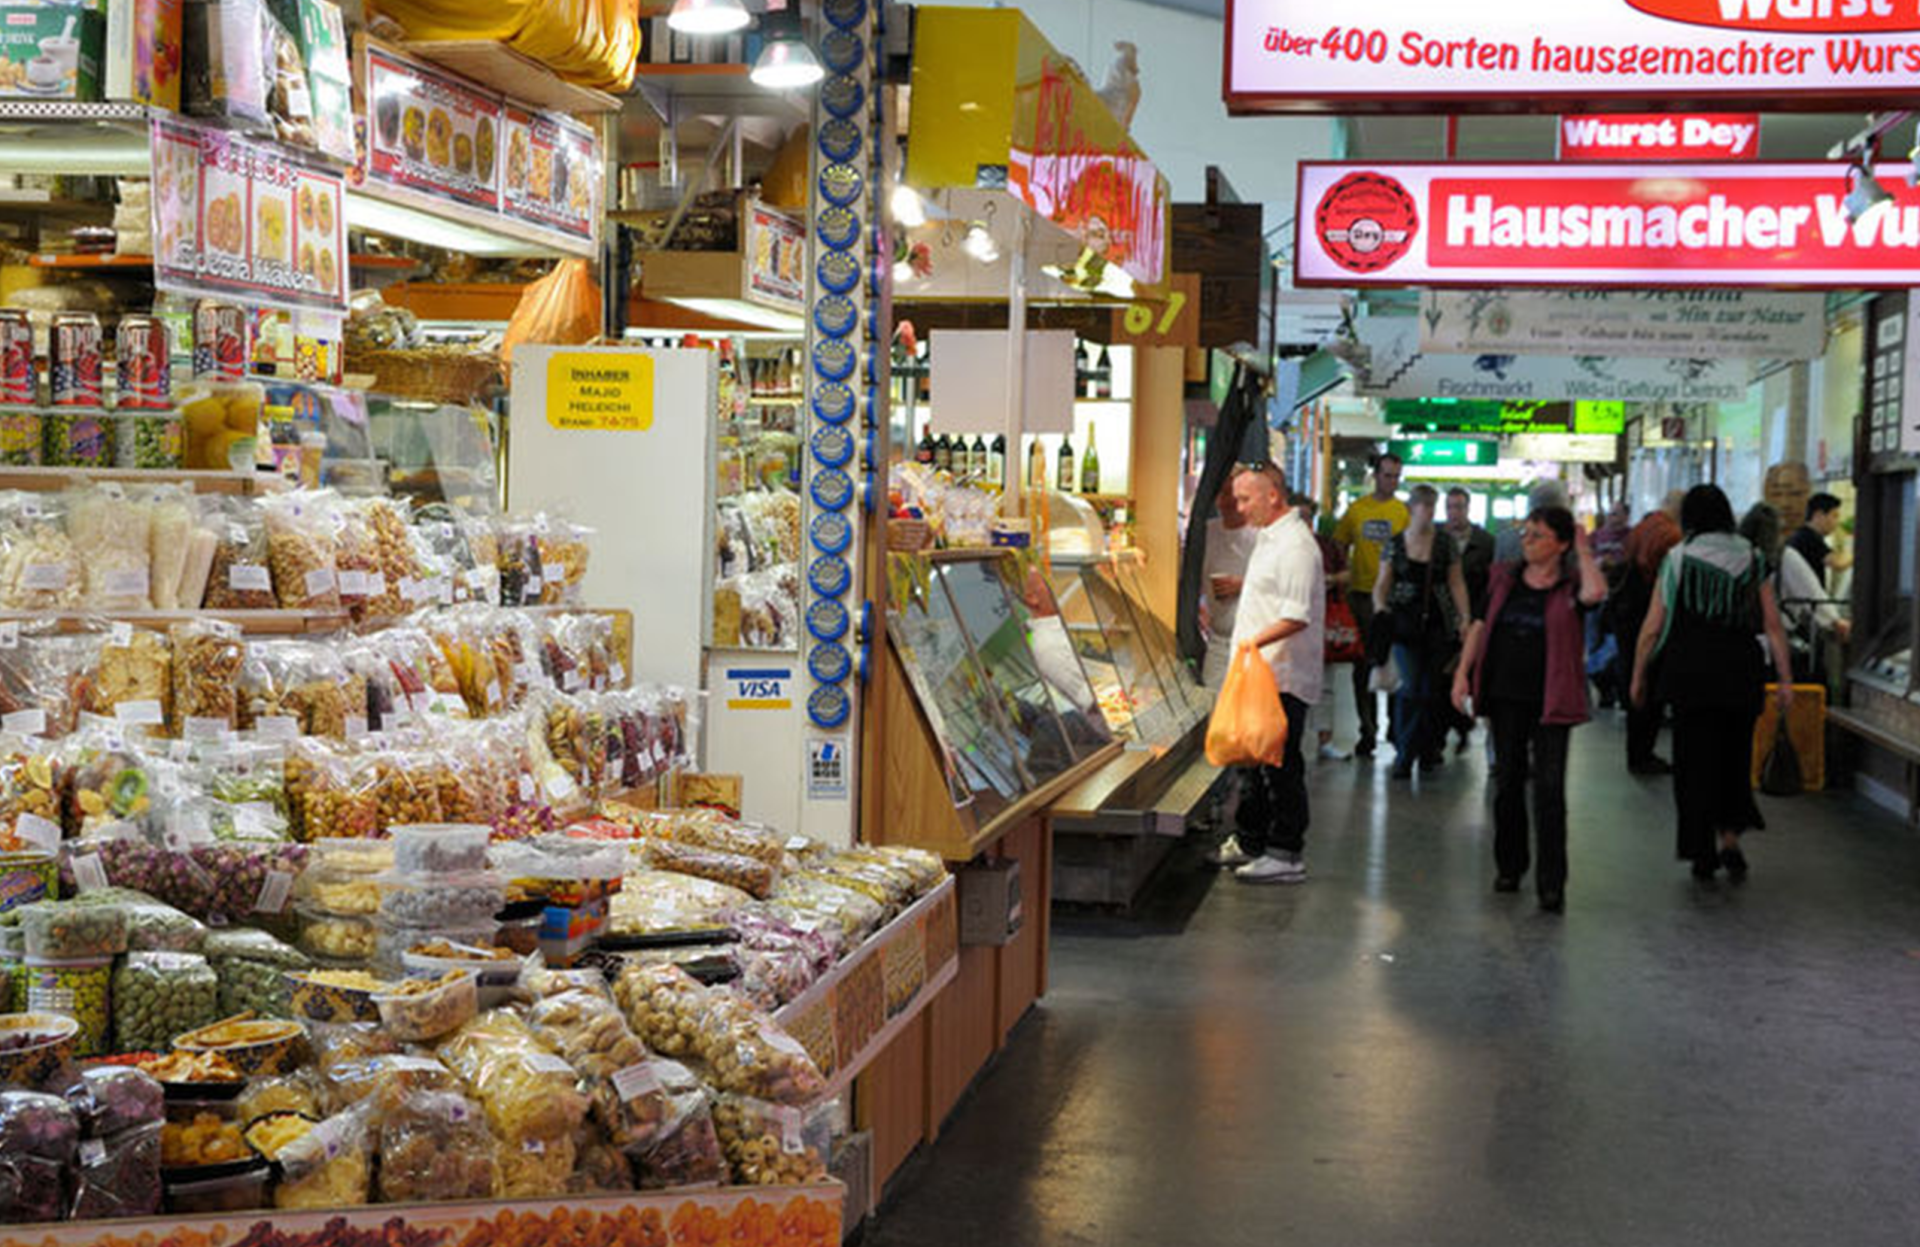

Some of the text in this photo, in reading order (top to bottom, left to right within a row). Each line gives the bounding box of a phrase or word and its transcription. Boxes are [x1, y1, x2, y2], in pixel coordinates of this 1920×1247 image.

[1264, 26, 1920, 75] über 400 Sorten hausgemachter Wurs
[1565, 119, 1755, 153] Wurst Dey
[1446, 194, 1811, 248] Hausmacher
[1438, 378, 1533, 397] Fischmarkt
[738, 681, 780, 697] VISA
